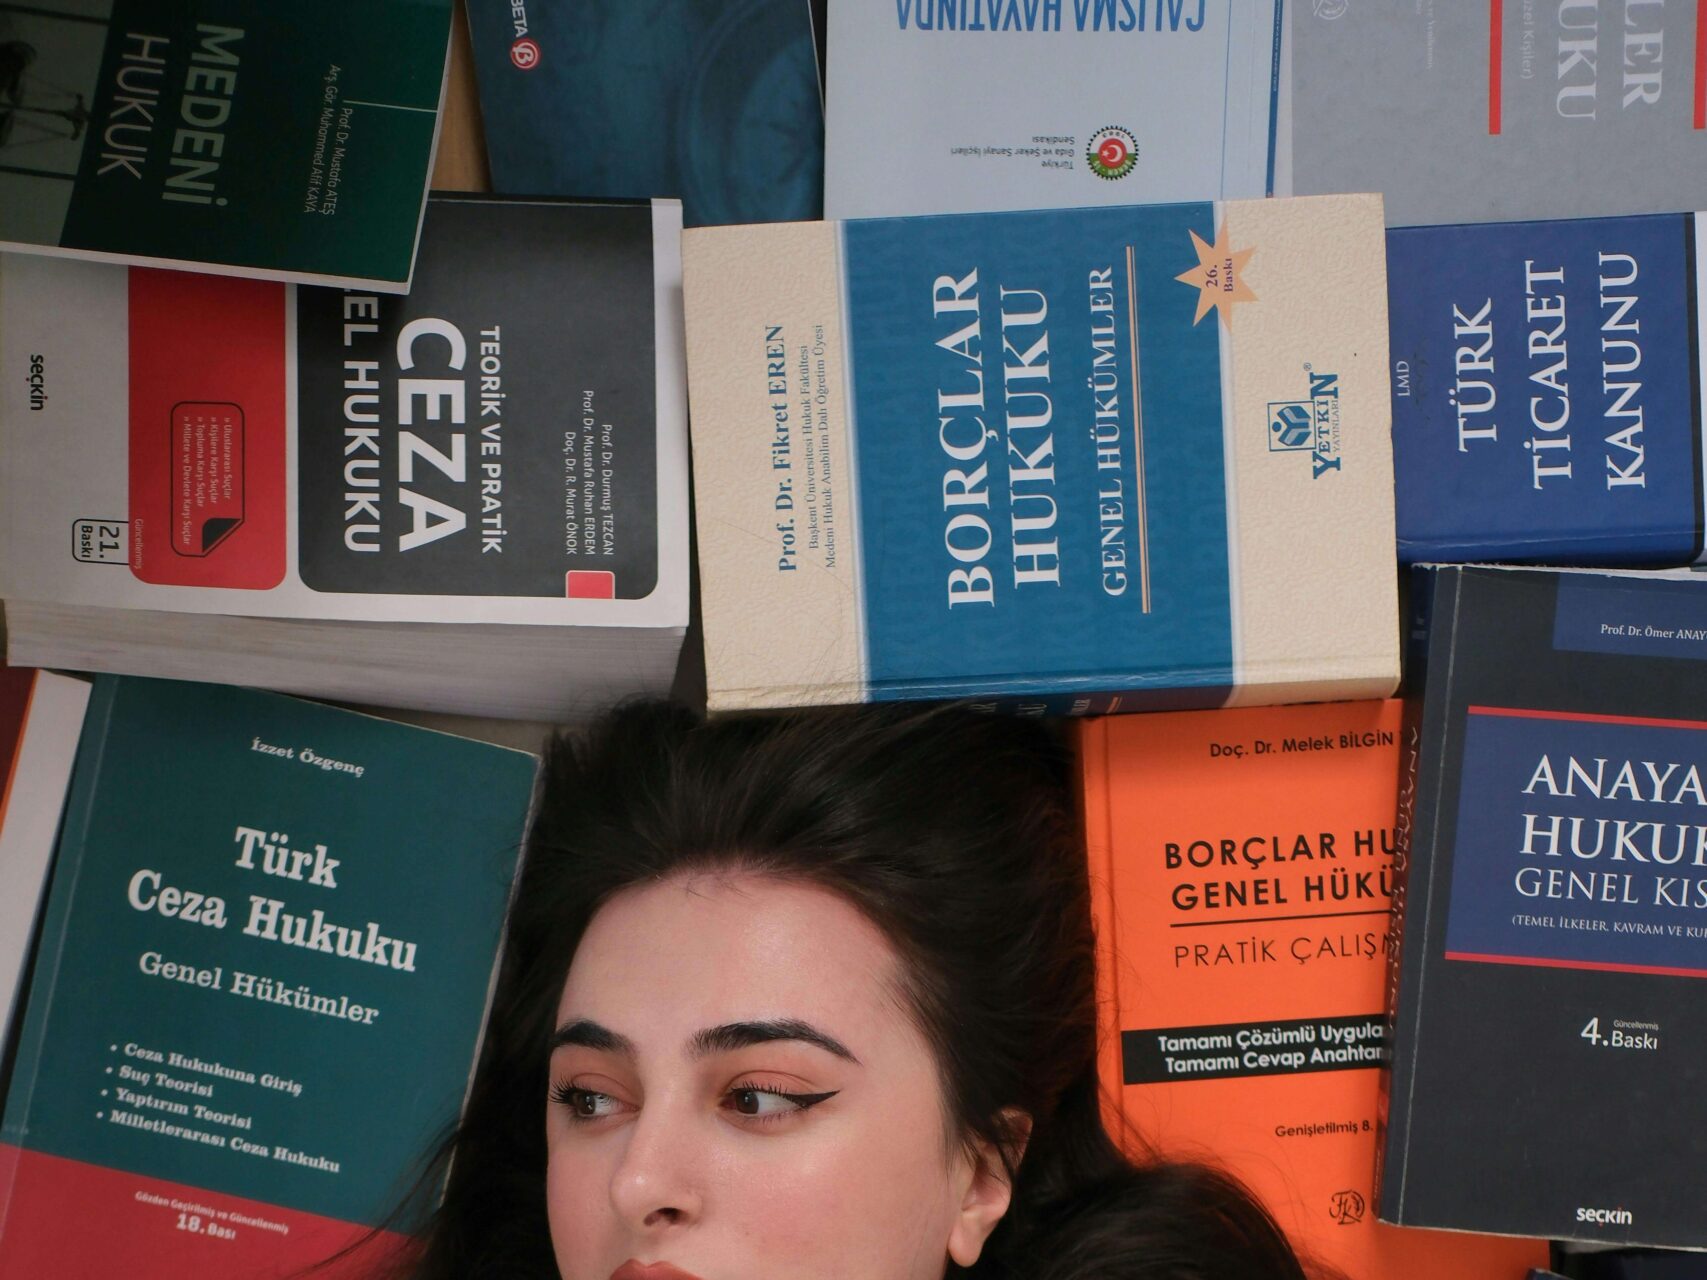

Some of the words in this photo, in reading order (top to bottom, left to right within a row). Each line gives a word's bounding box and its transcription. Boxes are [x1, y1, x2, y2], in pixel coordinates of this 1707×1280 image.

[96, 32, 170, 180] HUKUK
[324, 85, 339, 105] Gör.
[161, 23, 245, 207] MEDENİ
[337, 107, 354, 130] Prof.
[312, 107, 333, 166] Muhammed
[335, 131, 349, 145] Dr.
[309, 166, 323, 186] Afif
[327, 146, 347, 188] Mustafa
[303, 186, 320, 213] KAYA
[317, 188, 338, 216] ATEŞ
[1205, 264, 1219, 288] 26.
[1222, 257, 1234, 293] Baskı
[811, 324, 827, 356] Üyesi
[479, 325, 507, 417] TEORİK
[765, 326, 787, 395] EREN
[797, 345, 811, 395] Fakültesi
[1087, 266, 1121, 470] HÜKÜMLER
[1395, 360, 1411, 397] LMD
[1448, 297, 1497, 453] TÜRK
[1523, 259, 1572, 490] TİCARET
[1598, 251, 1646, 491] KANUNU
[814, 359, 830, 405] Öğretim
[582, 390, 595, 415] Prof.
[800, 398, 813, 435] Hukuk
[816, 407, 829, 431] Dalı
[182, 423, 193, 453] Millete
[194, 423, 206, 459] Topluma
[396, 317, 467, 552] CEZA
[480, 422, 501, 456] VE
[562, 431, 577, 455] Doç.
[582, 417, 595, 433] Dr.
[601, 423, 613, 449] Prof.
[771, 403, 792, 470] Fikret
[932, 267, 999, 610] BORÇLAR
[999, 284, 1061, 589] HUKUKU
[182, 453, 190, 464] ve
[223, 424, 233, 473] Uluslararası
[343, 360, 381, 553] HUKUKU
[564, 458, 577, 473] Dr.
[583, 435, 595, 478] Mustafa
[601, 451, 613, 466] Dr.
[818, 434, 831, 485] Anabilim
[182, 465, 193, 498] Devlete
[194, 460, 205, 481] Karşı
[221, 473, 233, 500] Suçlar
[565, 475, 577, 486] R.
[803, 437, 817, 503] Üniversitesi
[194, 481, 206, 508] Suçlar
[565, 488, 577, 520] Murat
[583, 480, 596, 515] Ruhan
[599, 468, 614, 511] Durmuş
[774, 477, 794, 511] Dr.
[820, 487, 834, 524] Hukuk
[181, 498, 192, 519] Karşı
[481, 463, 508, 554] PRATİK
[80, 524, 94, 558] Baskı
[98, 525, 120, 559] 21.
[181, 520, 192, 545] Suçlar
[565, 521, 579, 555] ÖNOK
[583, 517, 596, 555] ERDEM
[602, 513, 614, 556] TEZCAN
[775, 518, 797, 571] Prof.
[807, 505, 821, 549] Başkent
[1098, 478, 1128, 597] GENEL
[823, 527, 836, 568] Medeni
[1600, 623, 1626, 636] Prof.
[1627, 625, 1643, 637] Dr.
[1644, 625, 1675, 639] Ömer
[250, 736, 294, 759] İzzet
[298, 747, 365, 778] Özgenç
[1209, 742, 1249, 759] Doç.
[1253, 739, 1276, 755] Dr.
[1281, 735, 1334, 753] Melek
[1339, 731, 1394, 753] BİLGİN
[234, 825, 341, 889] Türk
[1164, 832, 1337, 870] BORÇLAR
[1171, 877, 1288, 911] GENEL
[1514, 867, 1639, 904] GENEL
[127, 868, 228, 929] Ceza
[242, 894, 417, 973] Hukuku
[1174, 935, 1277, 969] PRATİK
[138, 951, 223, 990] Genel
[229, 971, 380, 1025] Hükümler
[1157, 1035, 1232, 1052] Tamamı
[1235, 1025, 1316, 1051] Çözümlü
[1611, 1029, 1658, 1050] Baskı
[1612, 1019, 1660, 1032] Güncellenmiş
[123, 1042, 164, 1064] Ceza
[167, 1051, 256, 1084] Hukukuna
[259, 1073, 303, 1098] Giriş
[1164, 1056, 1240, 1073] Tamamı
[1242, 1051, 1306, 1069] Cevap
[118, 1064, 151, 1086] Suç
[154, 1072, 214, 1098] Teorisi
[115, 1086, 189, 1116] Yaptırım
[193, 1104, 252, 1130] Teorisi
[109, 1109, 226, 1147] Milletlerarası
[229, 1136, 269, 1158] Ceza
[272, 1146, 340, 1173] Hukuku
[1274, 1121, 1359, 1138] Genişletilmiş
[1361, 1119, 1373, 1132] 8.
[207, 1223, 236, 1238] Bası
